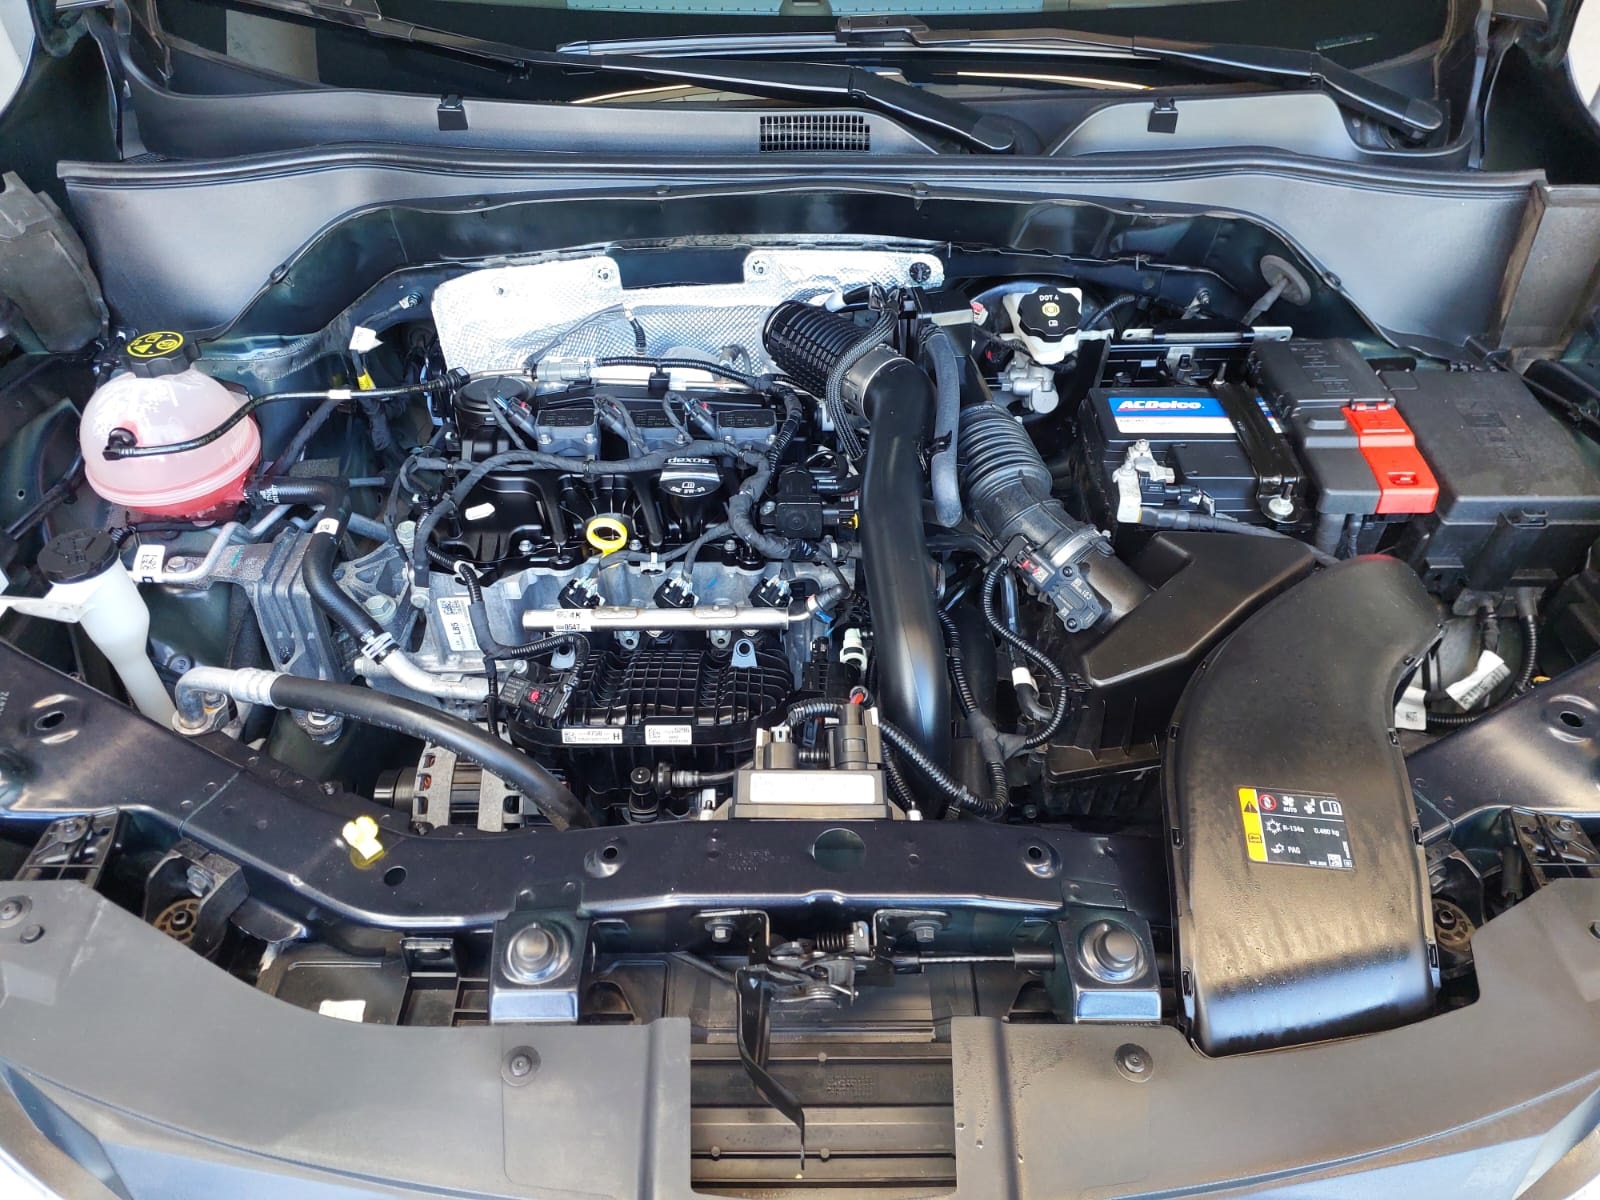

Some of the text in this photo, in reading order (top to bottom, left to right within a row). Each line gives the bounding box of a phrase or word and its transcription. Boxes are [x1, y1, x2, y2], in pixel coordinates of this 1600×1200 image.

[1118, 400, 1202, 410] ACDelco
[612, 731, 620, 741] H
[1331, 829, 1340, 837] kg
